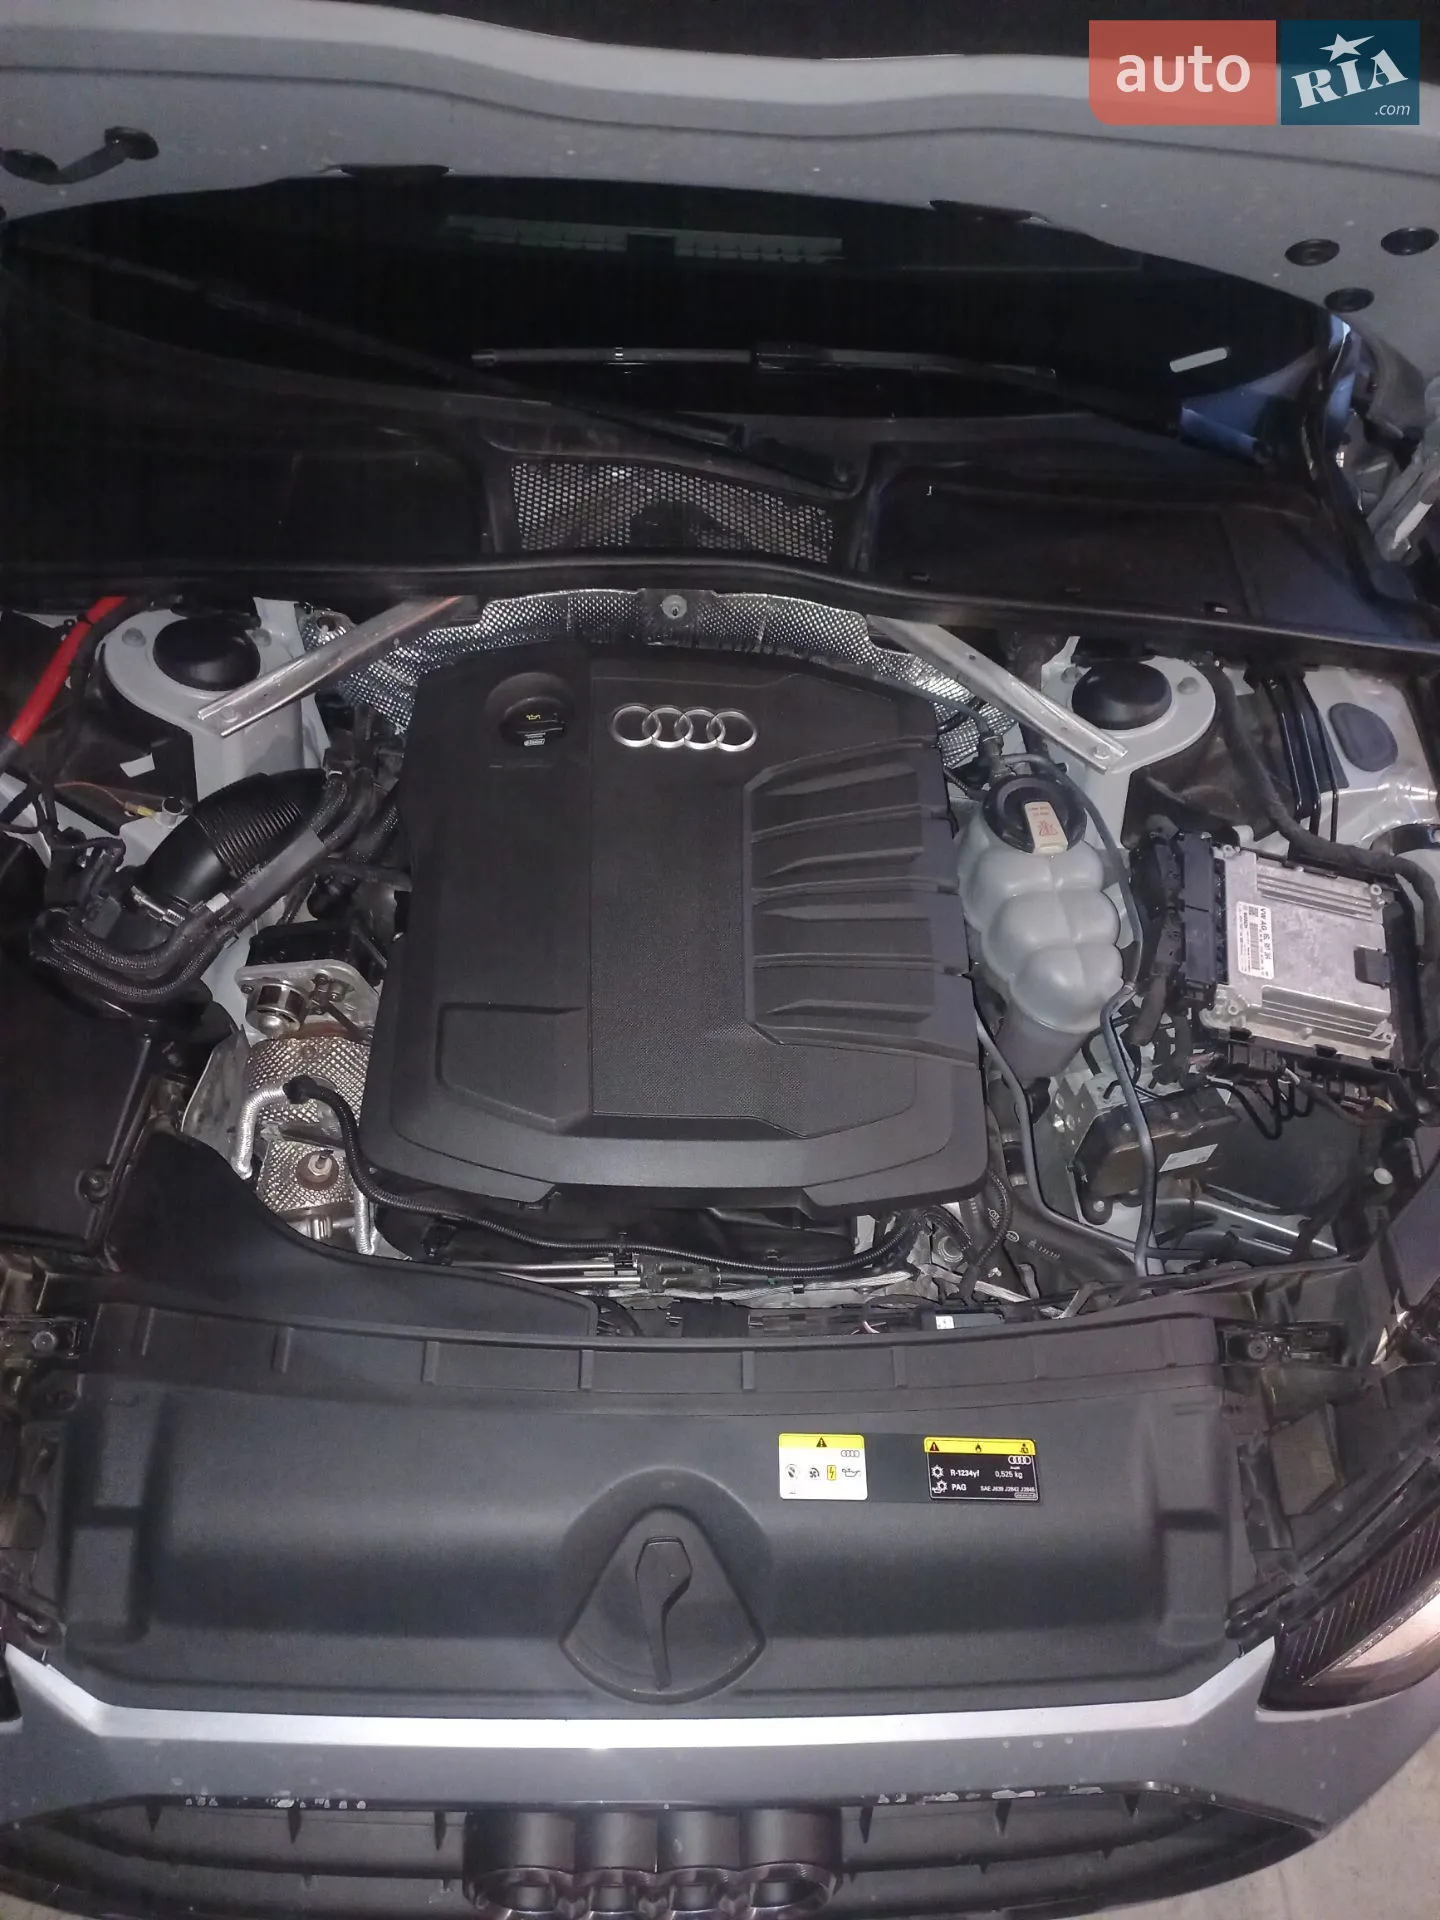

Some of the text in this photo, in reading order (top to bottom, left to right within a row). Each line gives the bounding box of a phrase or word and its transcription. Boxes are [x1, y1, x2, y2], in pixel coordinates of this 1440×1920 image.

[1261, 920, 1268, 931] AG
[950, 1469, 980, 1478] R-1234yf
[1014, 1471, 1023, 1480] kg
[951, 1483, 967, 1491] PAG
